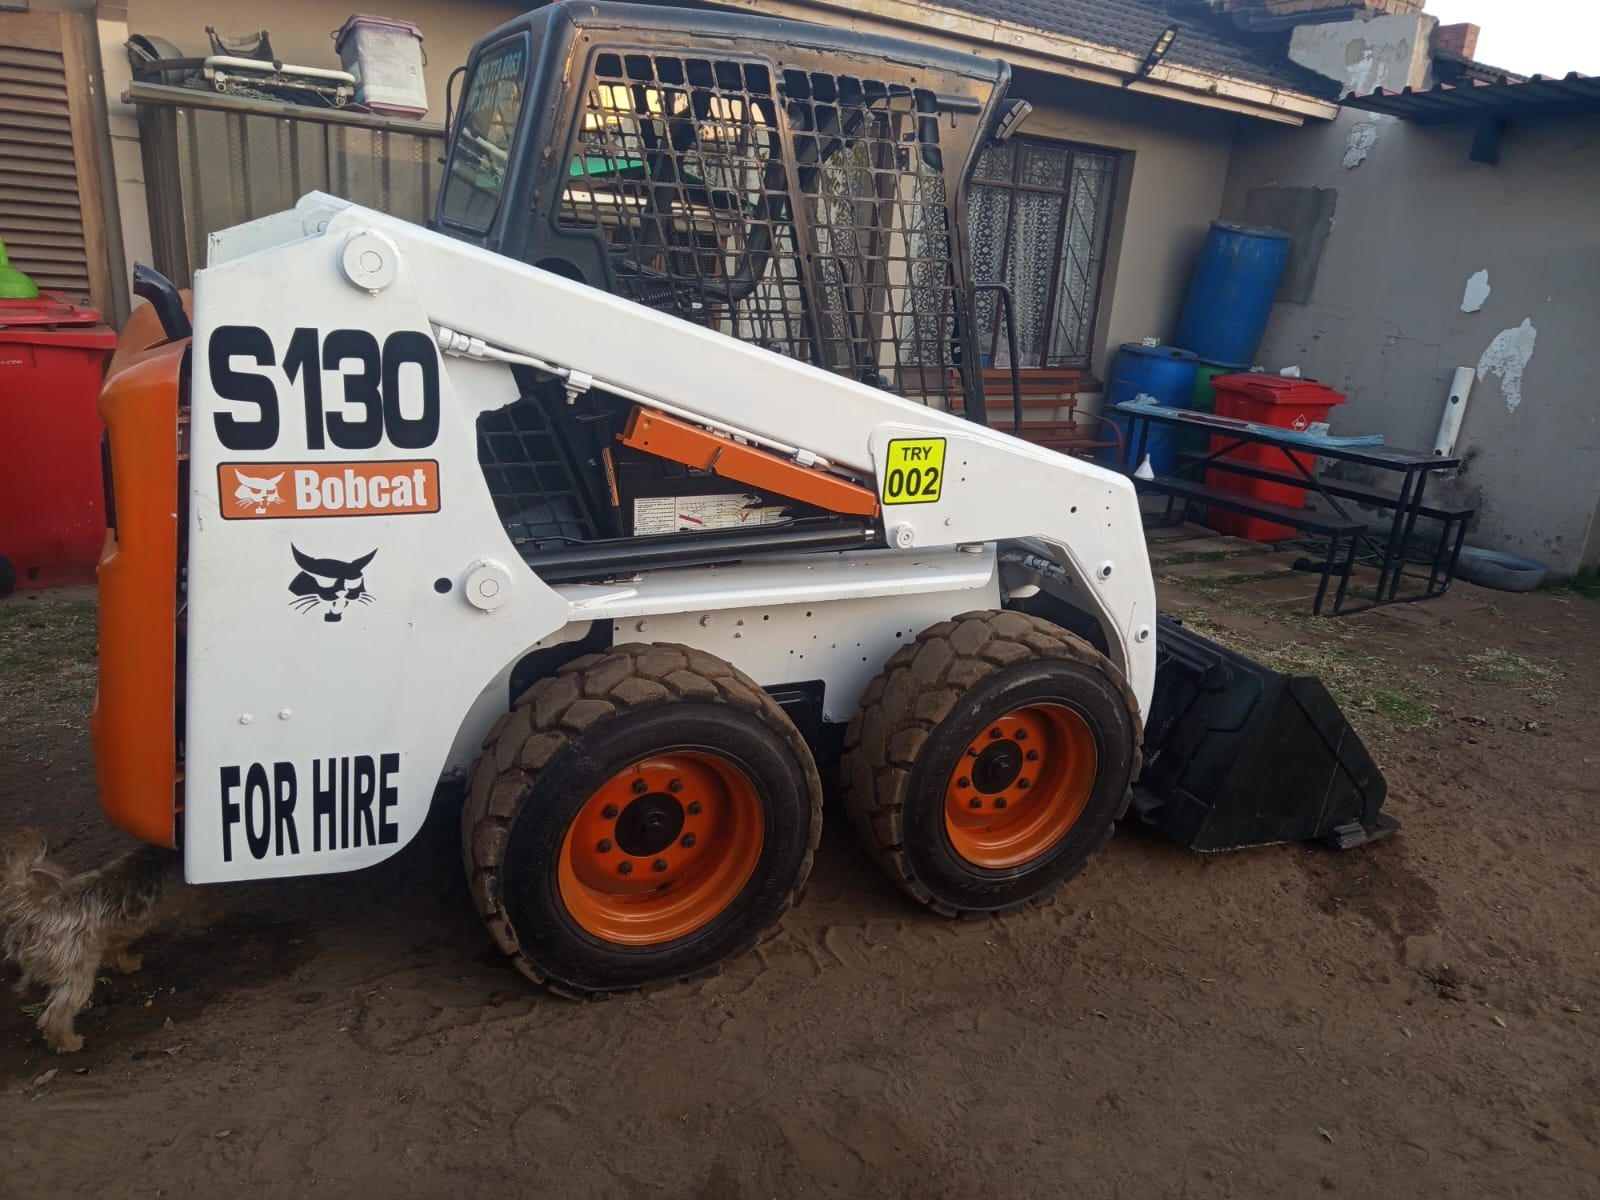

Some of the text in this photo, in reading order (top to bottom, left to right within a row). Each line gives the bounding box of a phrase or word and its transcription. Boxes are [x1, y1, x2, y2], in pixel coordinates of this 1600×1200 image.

[208, 325, 440, 450] S130
[901, 446, 933, 461] TRY
[294, 469, 428, 510] Bobcat
[888, 467, 939, 497] 002
[220, 753, 400, 862] FOR HIRE
